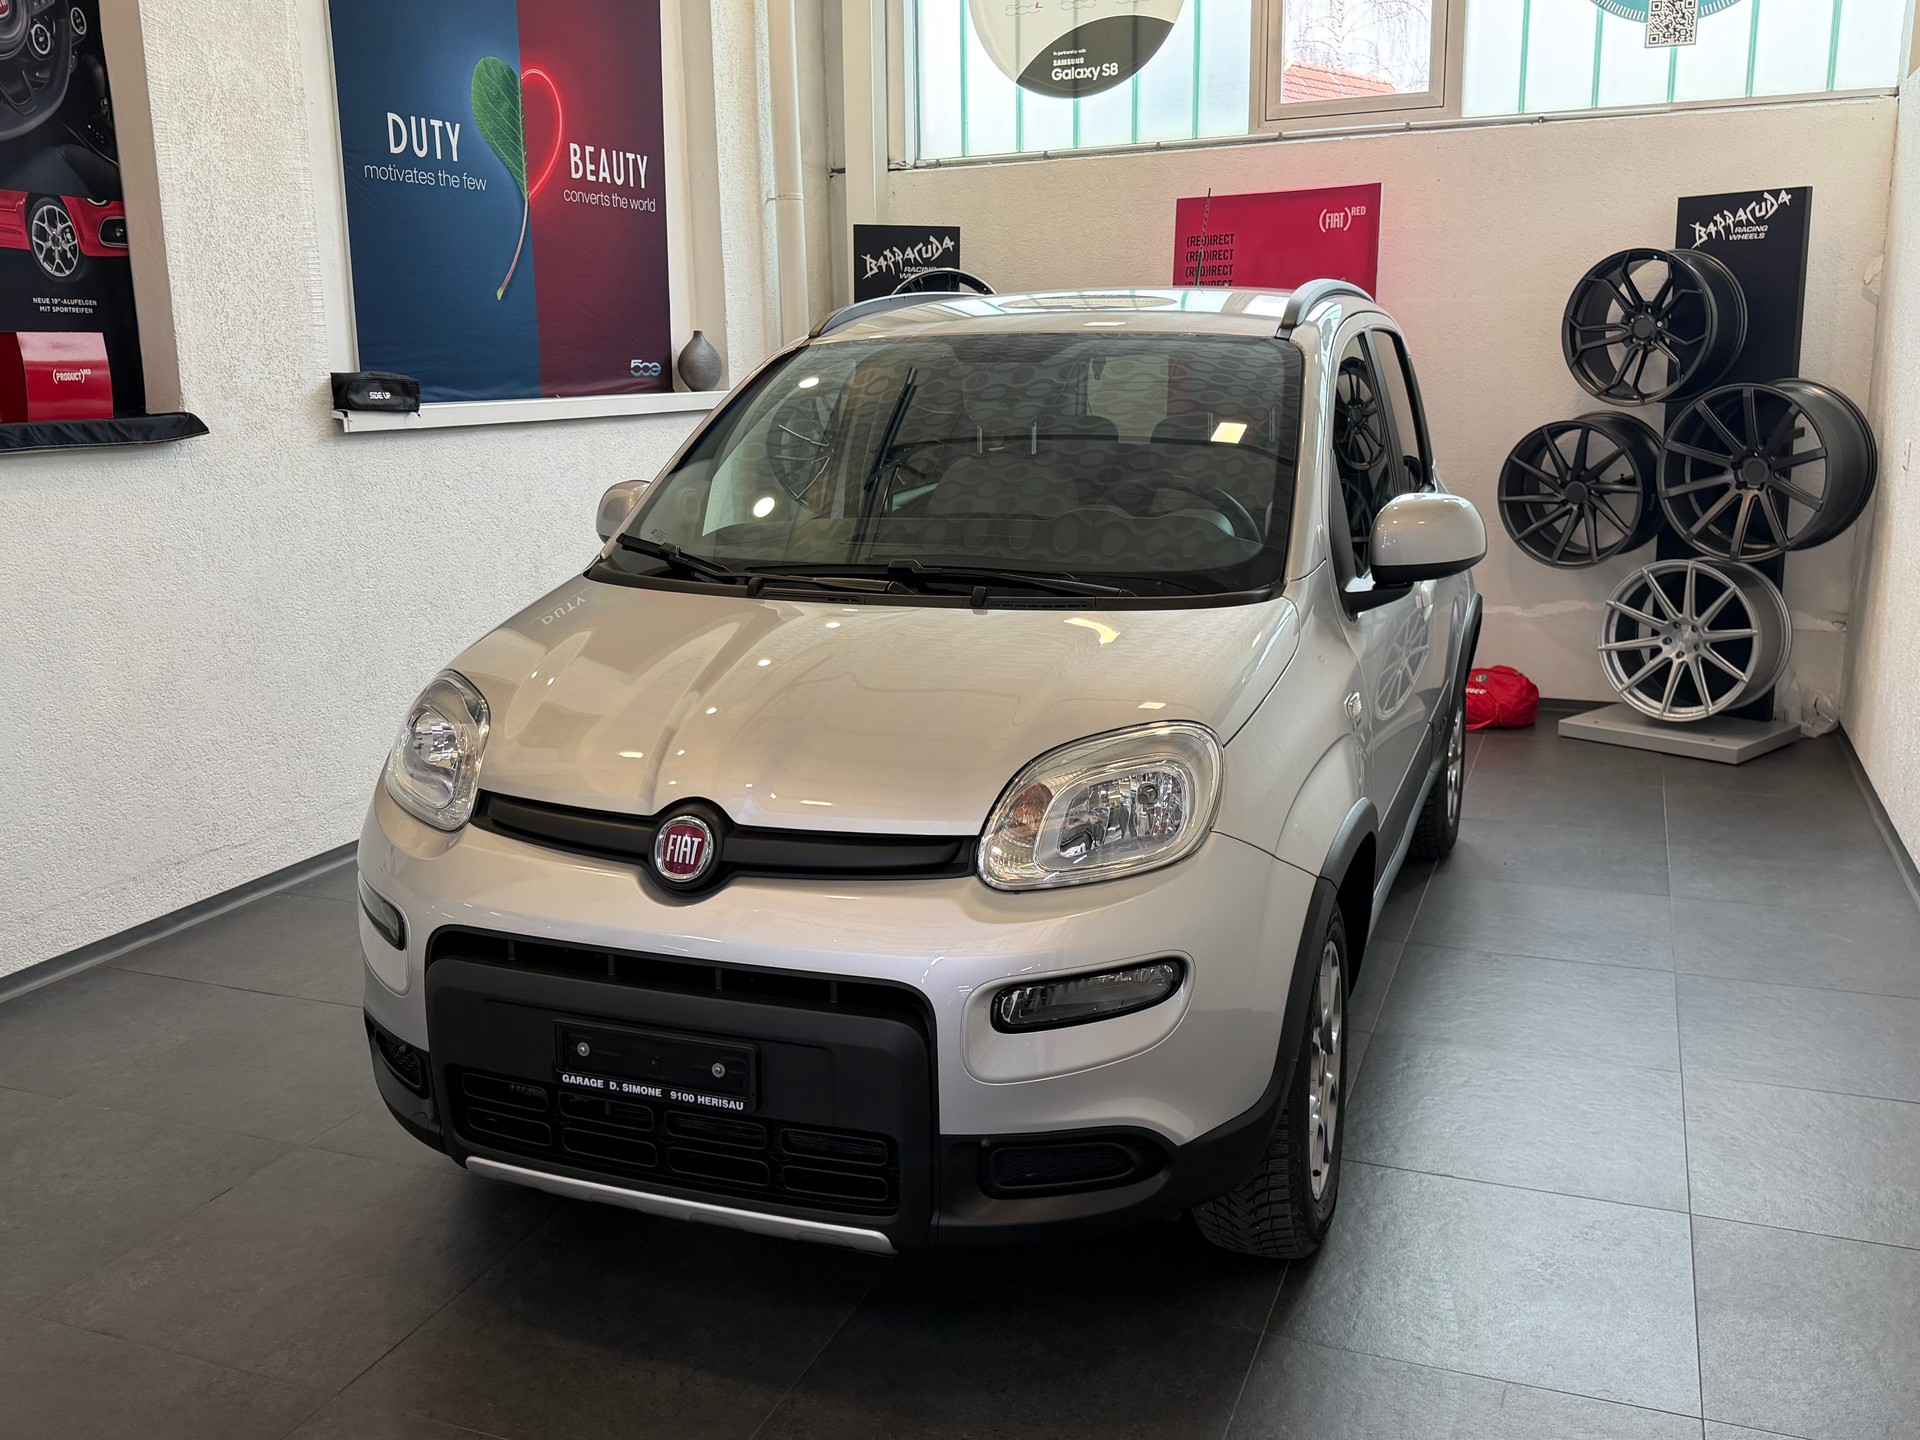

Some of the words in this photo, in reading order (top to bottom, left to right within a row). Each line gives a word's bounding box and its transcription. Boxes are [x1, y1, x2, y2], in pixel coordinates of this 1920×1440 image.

[1051, 66, 1101, 81] Galaxy
[1101, 62, 1119, 77] S8
[1053, 57, 1085, 66] SAMSUNG
[386, 111, 461, 162] DUTY
[364, 164, 436, 186] motivates
[438, 169, 460, 188] the
[462, 172, 487, 191] few
[569, 142, 648, 189] BEAUTY
[563, 189, 611, 207] converts
[611, 193, 628, 209] the
[629, 197, 656, 213] world
[1689, 189, 1792, 250] BARRACUDA
[1734, 225, 1769, 233] RACING
[1729, 232, 1766, 241] WHEELS
[860, 234, 955, 280] BARRACUDA
[1185, 264, 1234, 278] (RD)IRECT
[52, 306, 94, 314] SPORTREIFEN
[665, 834, 703, 866] FIAT
[562, 1074, 604, 1089] GARAGE
[609, 1081, 620, 1091] D.
[622, 1083, 662, 1097] SIMONE
[670, 1091, 695, 1103] 9100
[697, 1095, 744, 1111] HERISAU
